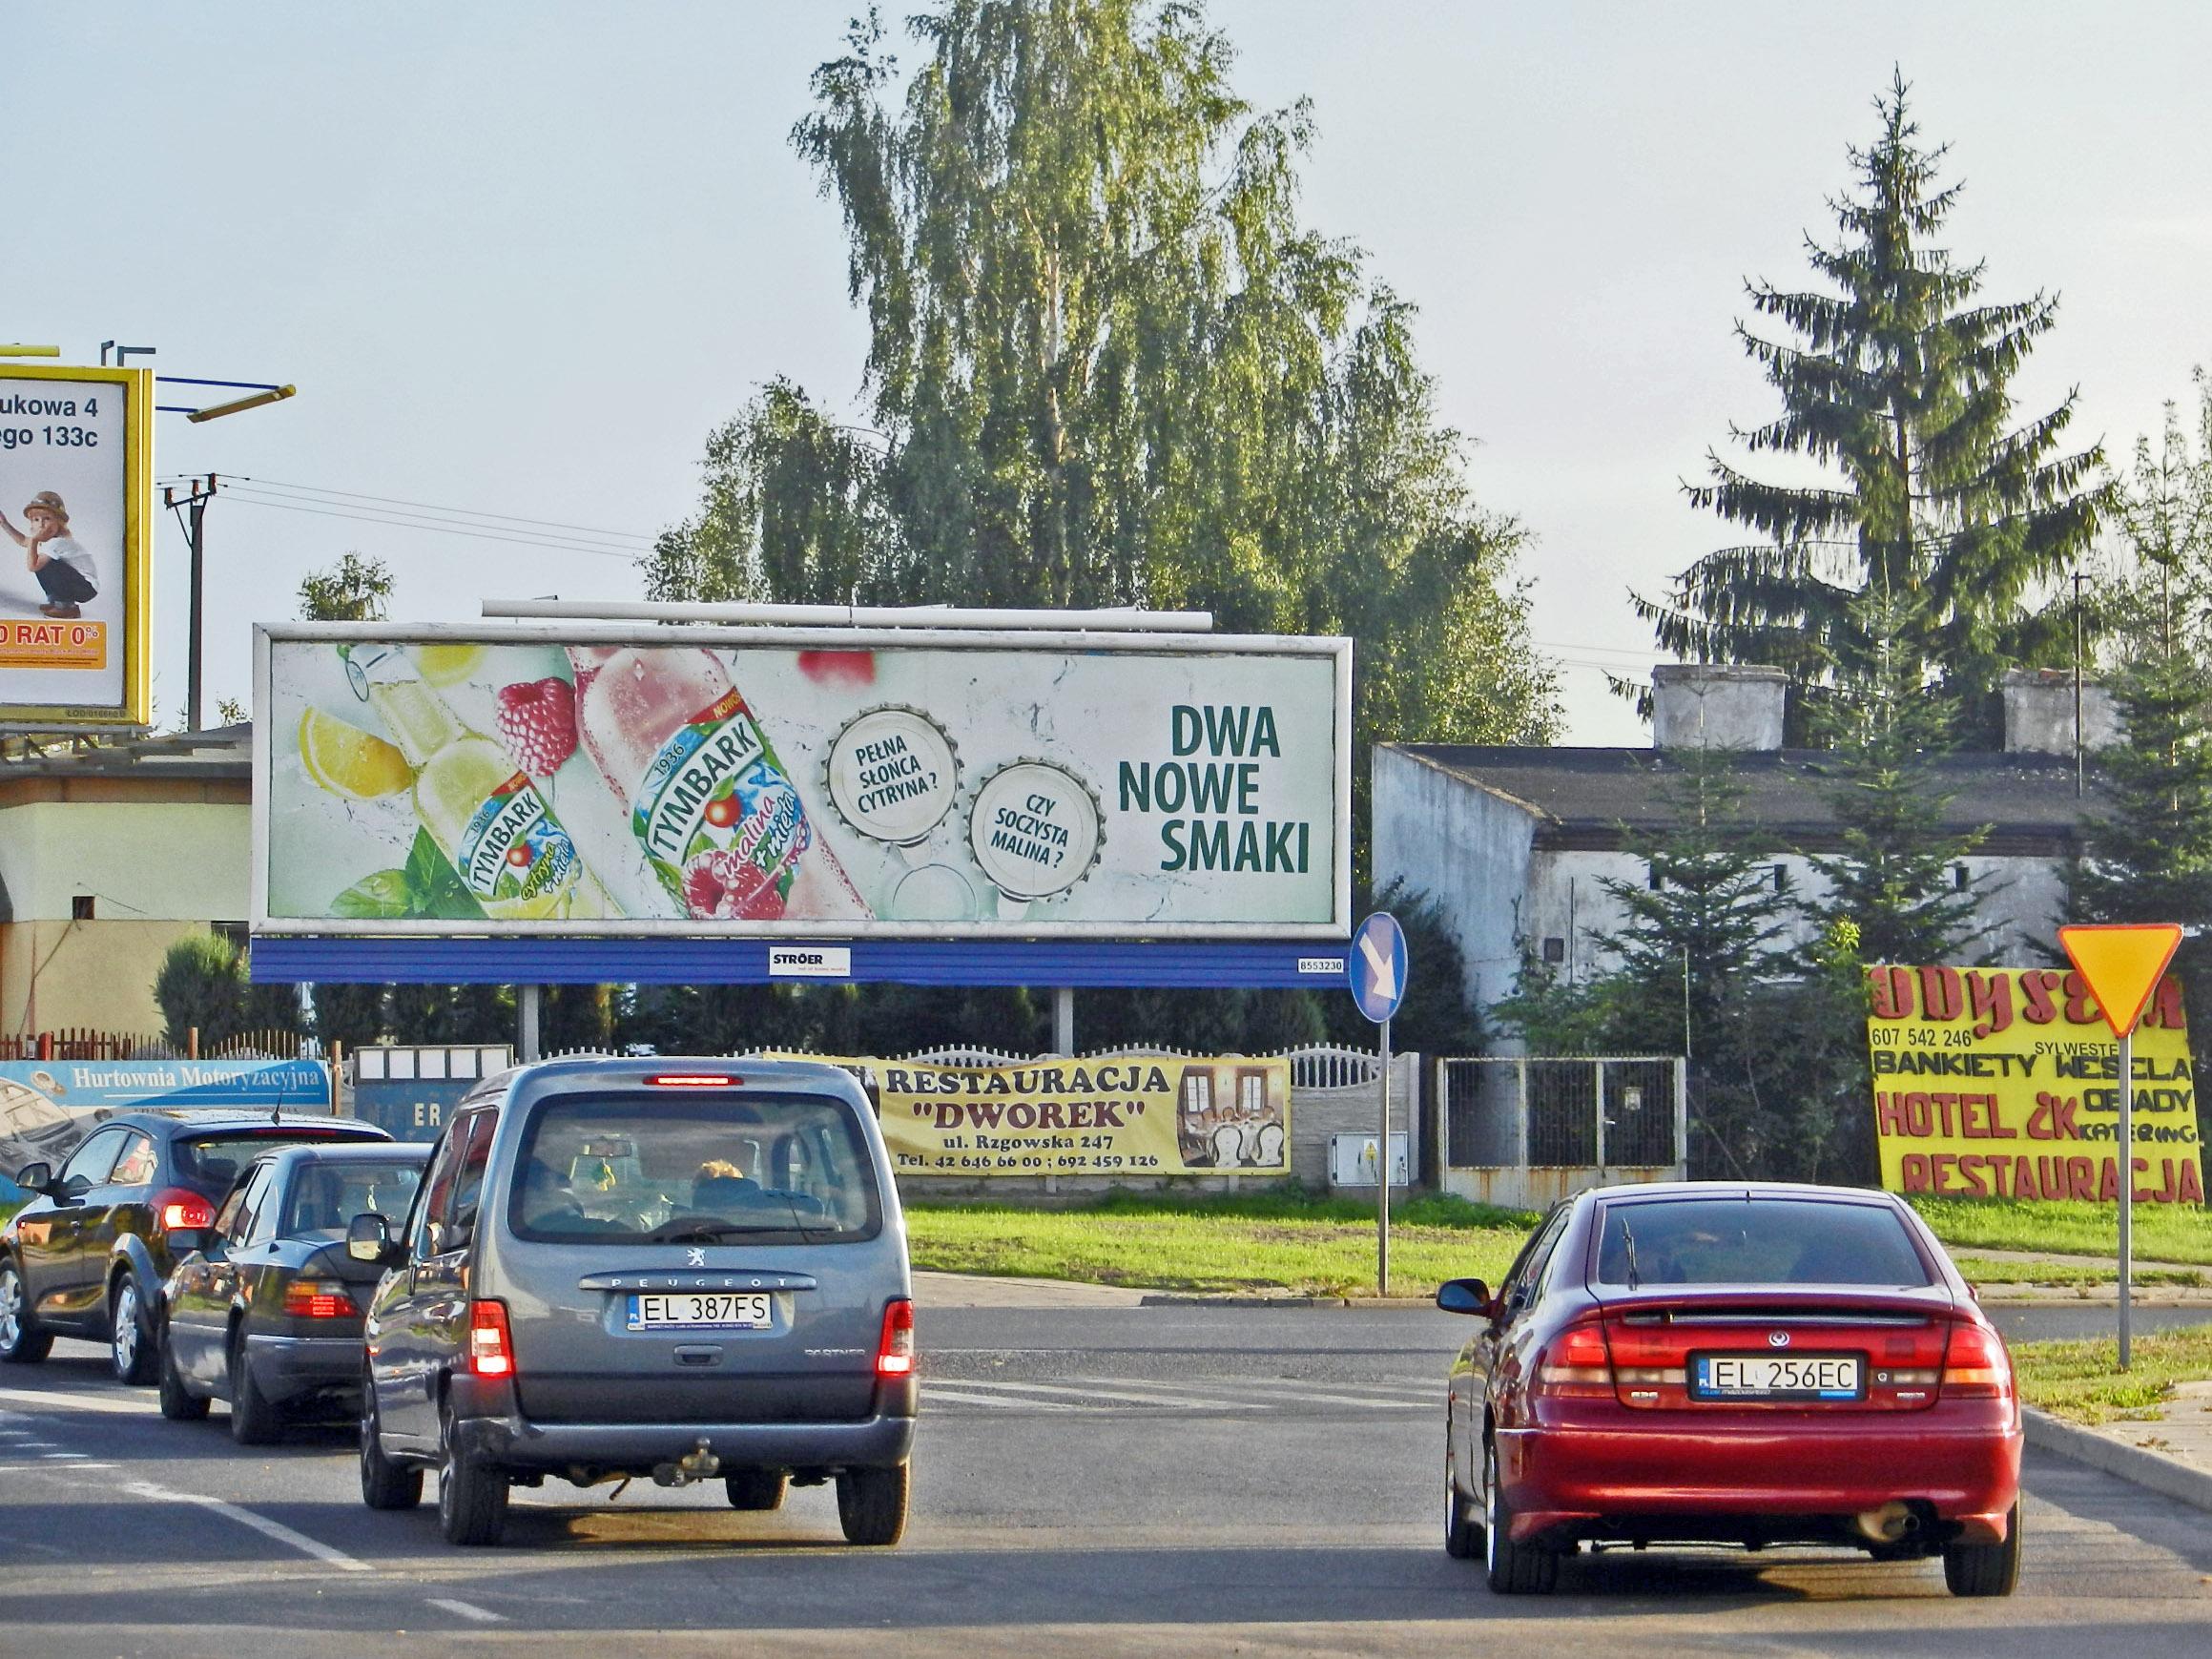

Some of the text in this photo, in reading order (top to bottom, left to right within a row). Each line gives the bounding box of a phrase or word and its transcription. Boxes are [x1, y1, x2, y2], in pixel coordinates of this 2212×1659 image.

[84, 398, 98, 417] 4
[0, 425, 98, 449] go 133c
[16, 625, 64, 644] RAT
[72, 626, 98, 645] 0%
[1172, 705, 1281, 757] DWA
[654, 743, 685, 776] 1936
[856, 735, 907, 766] PEŁNA
[653, 721, 757, 853] TYMBARK
[859, 755, 921, 789] SŁOŃCA
[1119, 761, 1259, 814] NOWE
[858, 777, 929, 813] CYTRYNA
[1026, 794, 1056, 817] CZY
[473, 792, 540, 886] TYMBARK
[723, 796, 776, 879] malina
[995, 807, 1068, 847] SOCZYSTA
[991, 830, 1050, 865] MALINA
[1161, 819, 1310, 873] SMAKI
[521, 840, 557, 901] cytryna
[1300, 961, 1342, 970] 8553230
[1872, 1028, 1973, 1047] 607 542 246
[72, 1066, 320, 1090] Hurtownia Motoryzacyjna
[886, 1067, 1171, 1094] RESTAURACJA
[1873, 1049, 2192, 1081] BANKIETY WESELA
[913, 1101, 1146, 1129] "DWOREK"
[1876, 1091, 2017, 1139] HOTEL
[943, 1135, 1114, 1152] ul. Rzgowska 247
[898, 1153, 929, 1167] Tel.
[935, 1155, 955, 1167] 42
[961, 1156, 991, 1167] 646
[997, 1155, 1017, 1167] 66
[1023, 1157, 1043, 1167] 00
[1058, 1155, 1086, 1168] 692
[1092, 1155, 1123, 1168] 459
[1129, 1154, 1158, 1167] 126
[1901, 1153, 2204, 1204] RESTAURACJA
[611, 1278, 787, 1287] PEUGEOT
[644, 1296, 766, 1321] EL 387FS
[1716, 1361, 1853, 1388] EL 256EC
